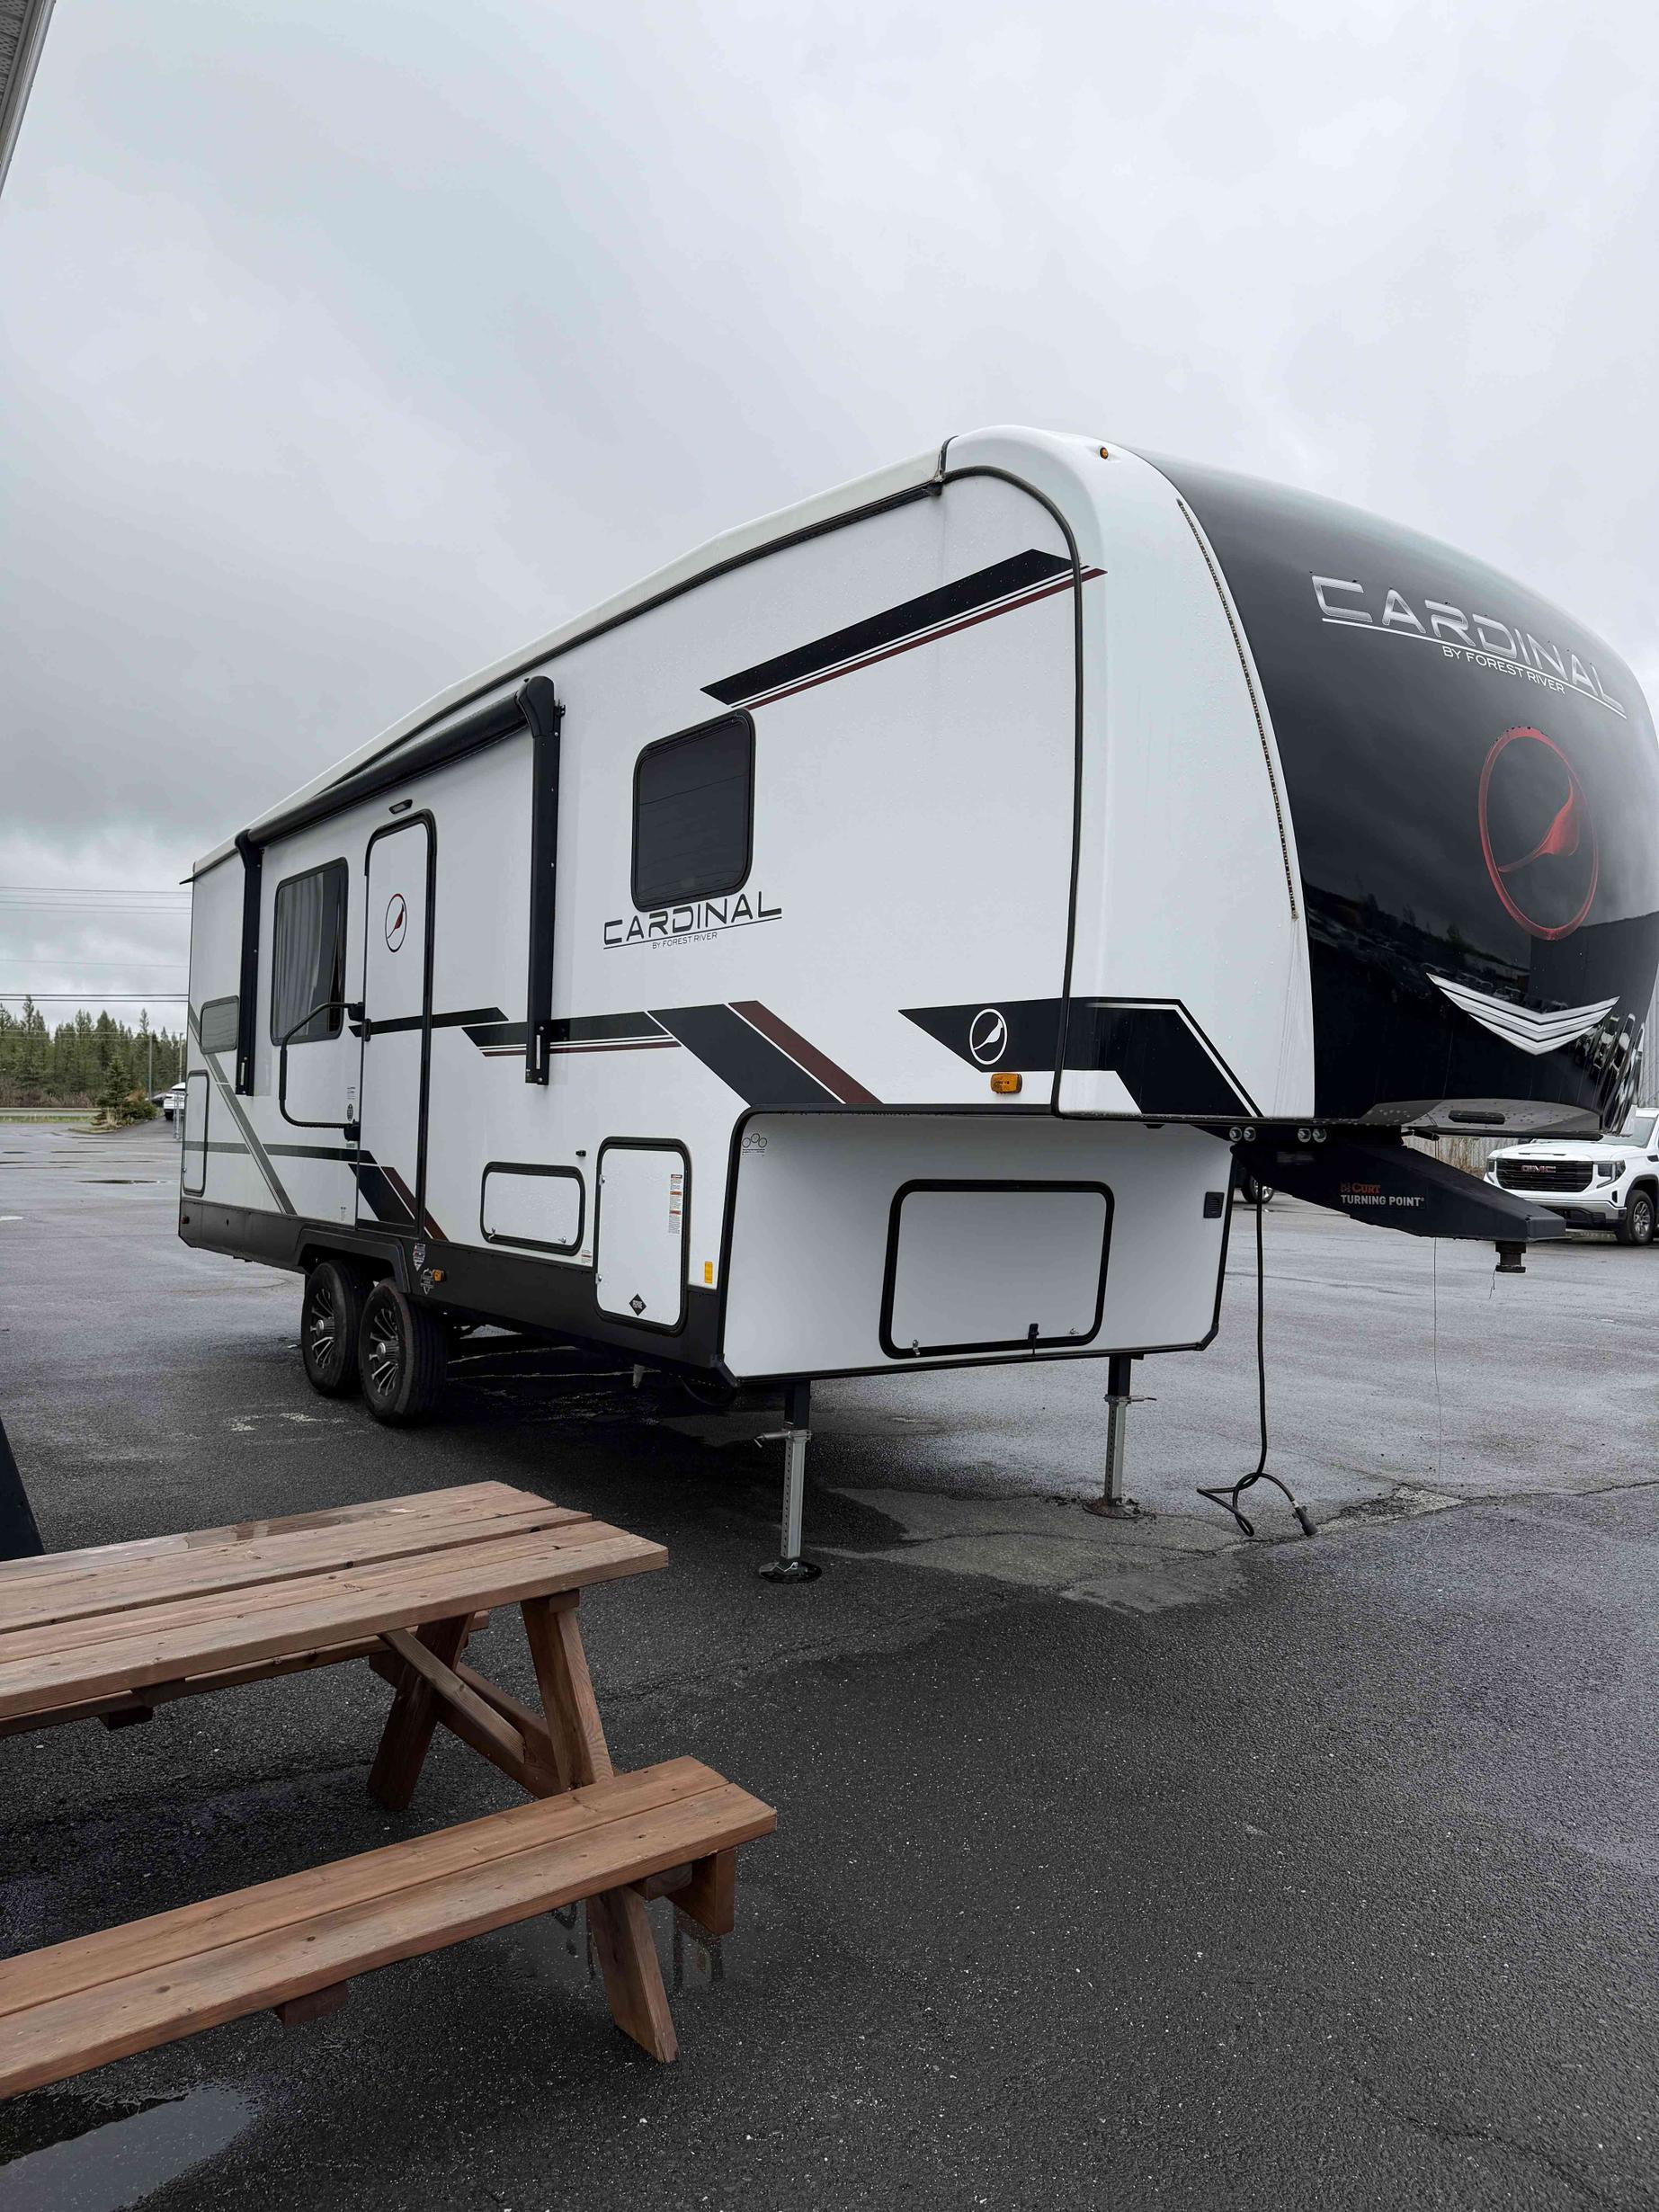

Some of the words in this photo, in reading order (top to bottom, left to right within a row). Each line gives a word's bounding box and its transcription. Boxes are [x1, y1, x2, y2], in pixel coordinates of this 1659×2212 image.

[1311, 575, 1625, 713] CARDINAL
[1442, 646, 1461, 659] BY
[1466, 651, 1523, 678] FOREST
[1526, 670, 1565, 694] RIVER
[603, 891, 782, 945] CARDINAL
[652, 941, 662, 950] BY
[663, 935, 691, 947] FOREST
[693, 932, 718, 942] RIVER
[1340, 1194, 1387, 1205] TURNING
